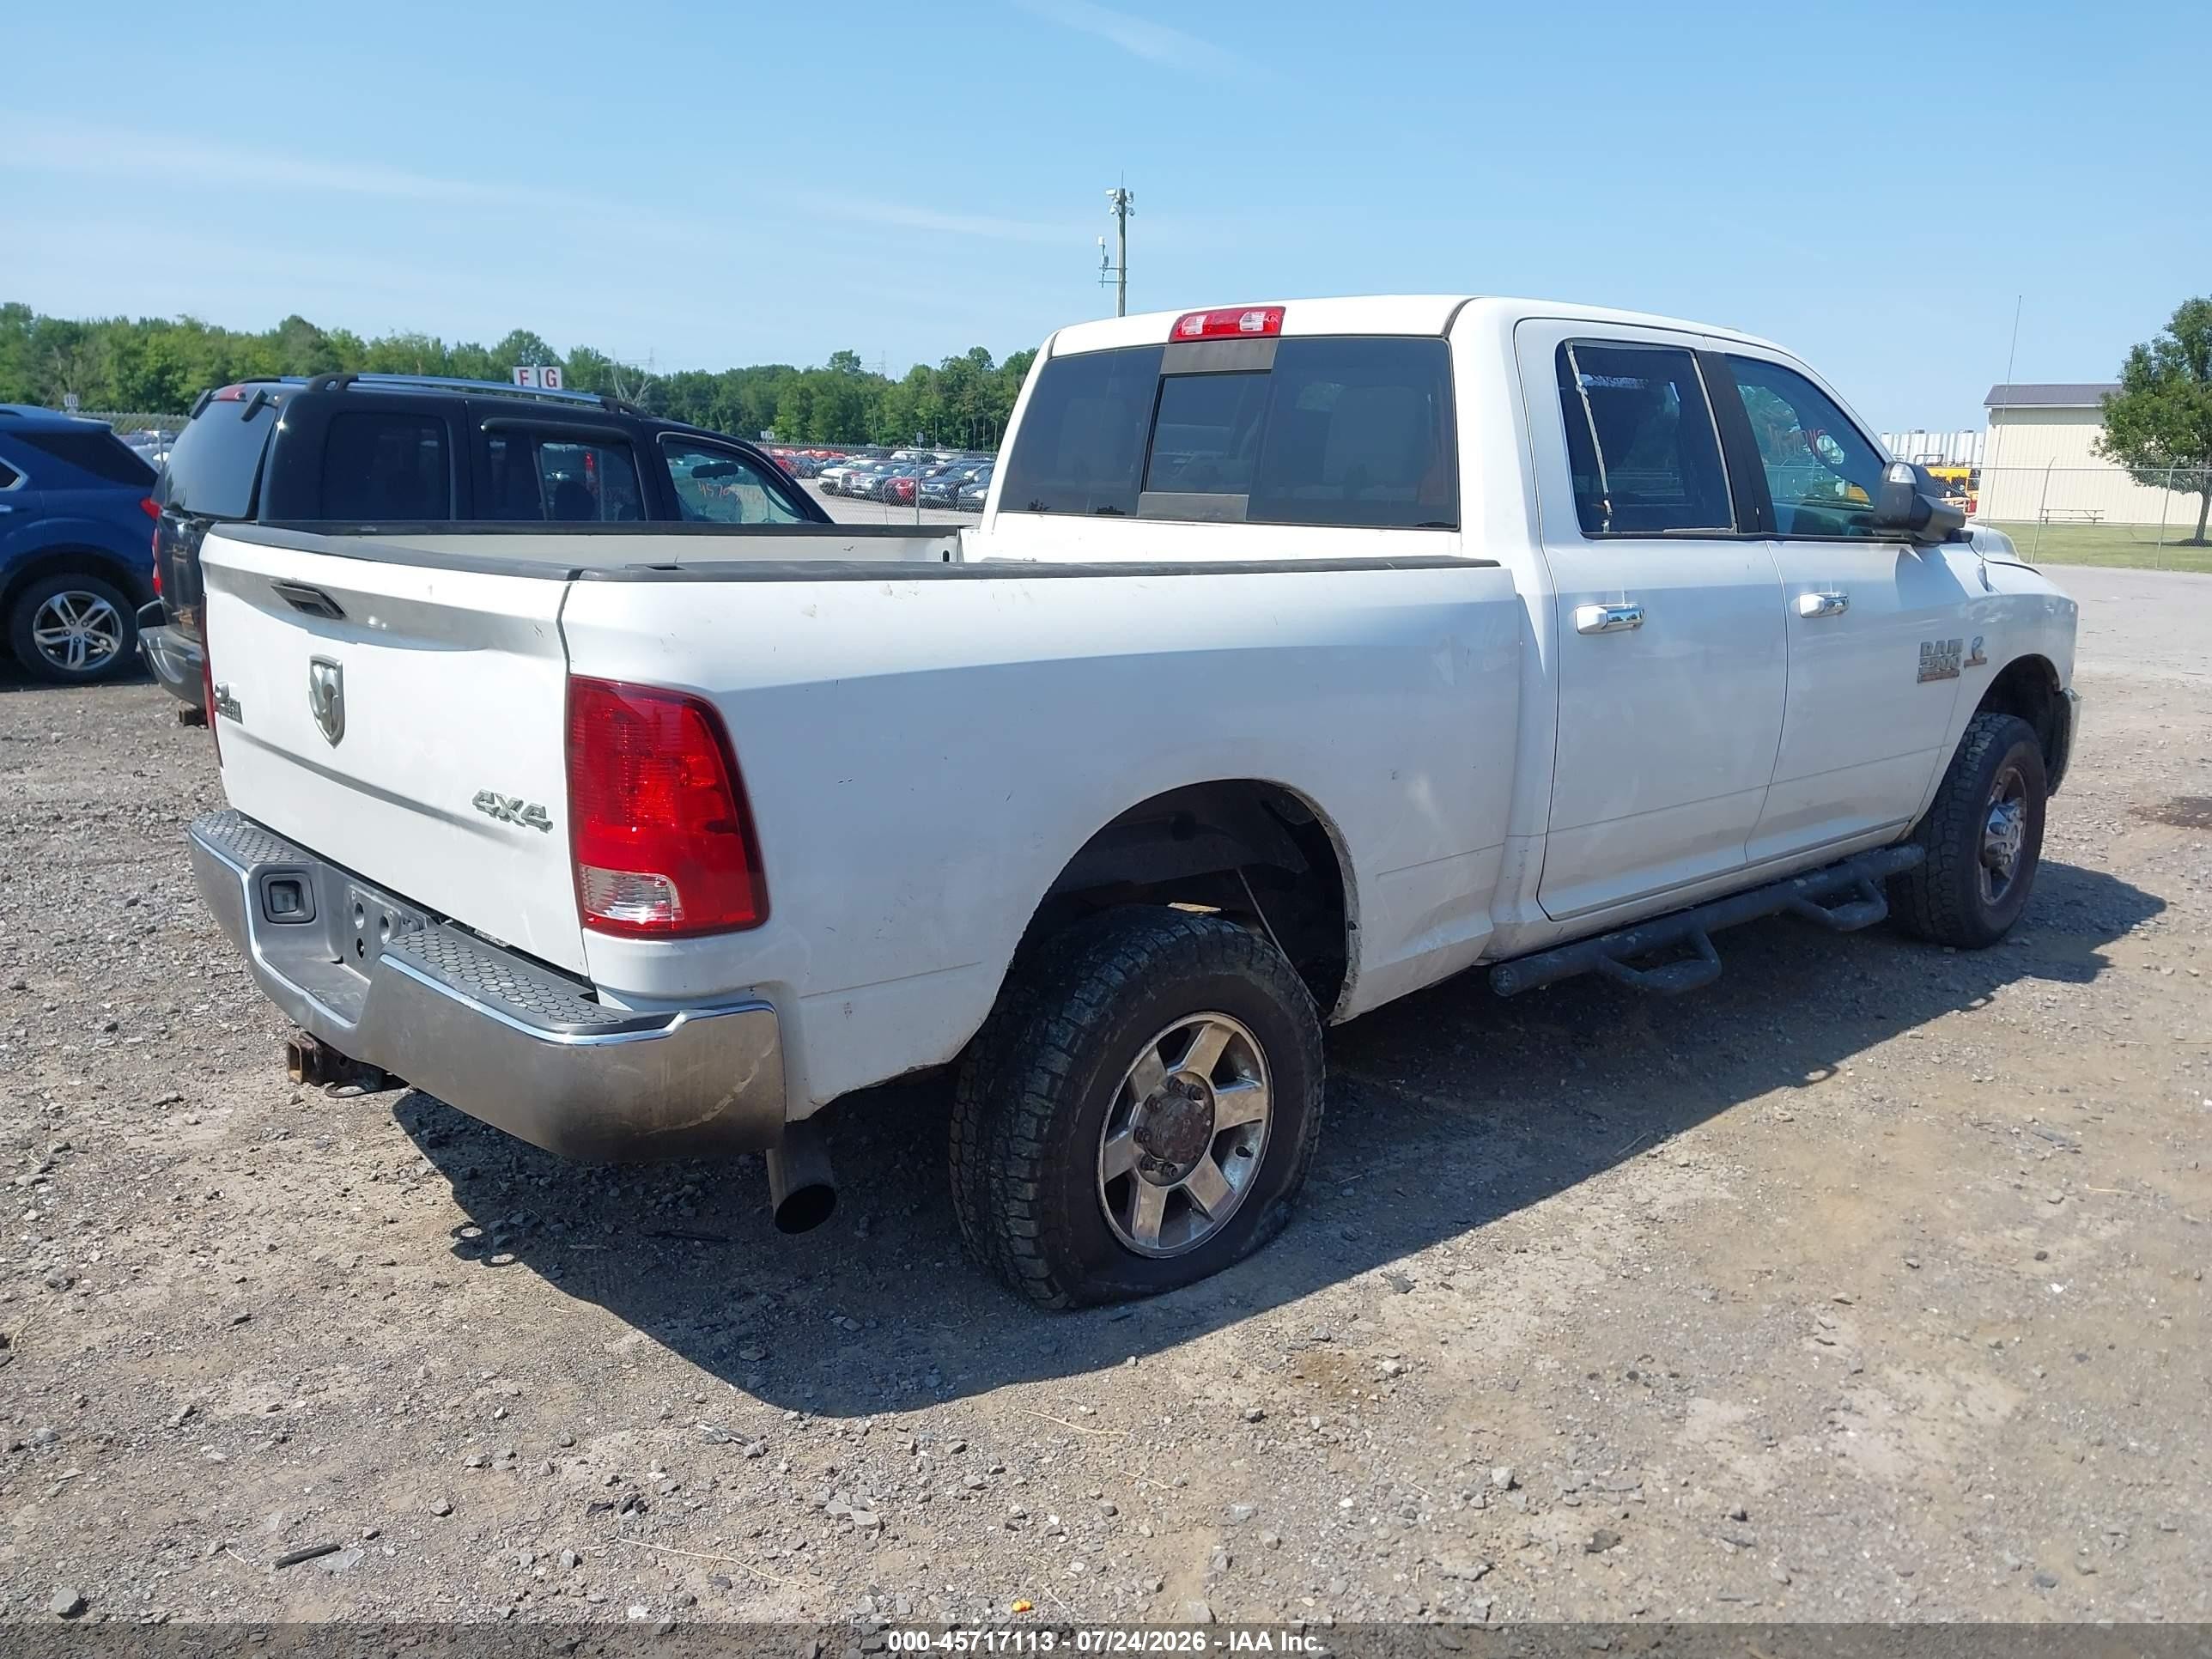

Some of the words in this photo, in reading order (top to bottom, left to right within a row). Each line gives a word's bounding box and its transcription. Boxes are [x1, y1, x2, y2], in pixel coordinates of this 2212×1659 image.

[519, 369, 529, 386] F
[546, 368, 557, 387] G
[1920, 639, 1963, 653] RAM
